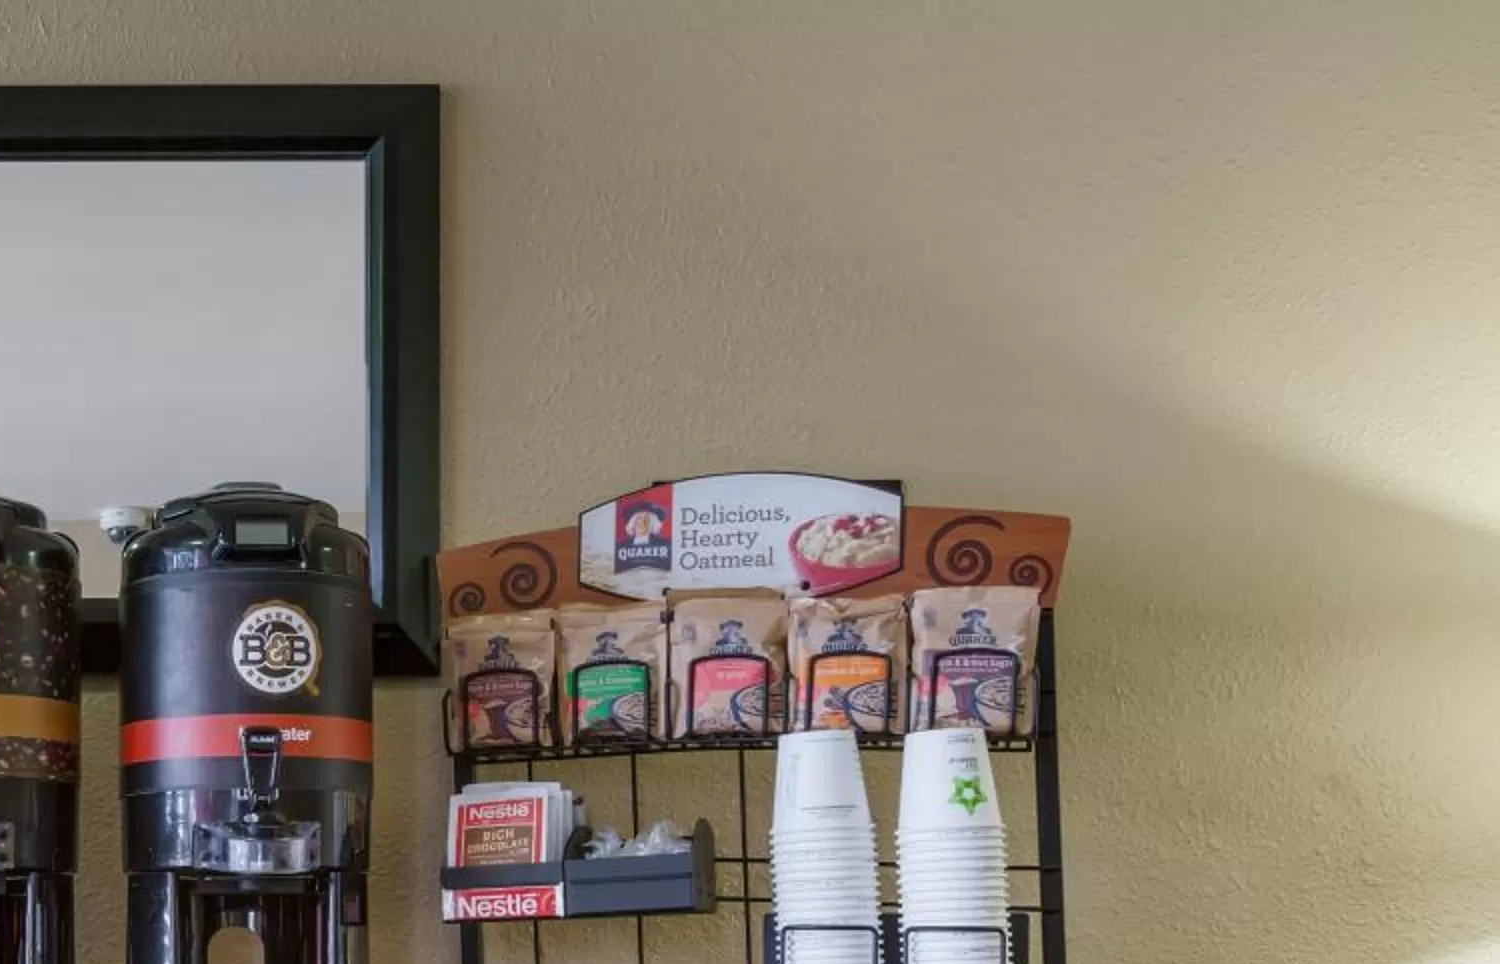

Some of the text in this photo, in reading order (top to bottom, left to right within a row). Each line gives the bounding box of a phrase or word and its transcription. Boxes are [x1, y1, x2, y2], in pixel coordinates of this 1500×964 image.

[679, 504, 792, 526] Delicious,
[679, 529, 760, 550] Hearty
[618, 546, 669, 561] QUAKER
[679, 547, 775, 571] Oatmeal
[279, 727, 312, 742] ater
